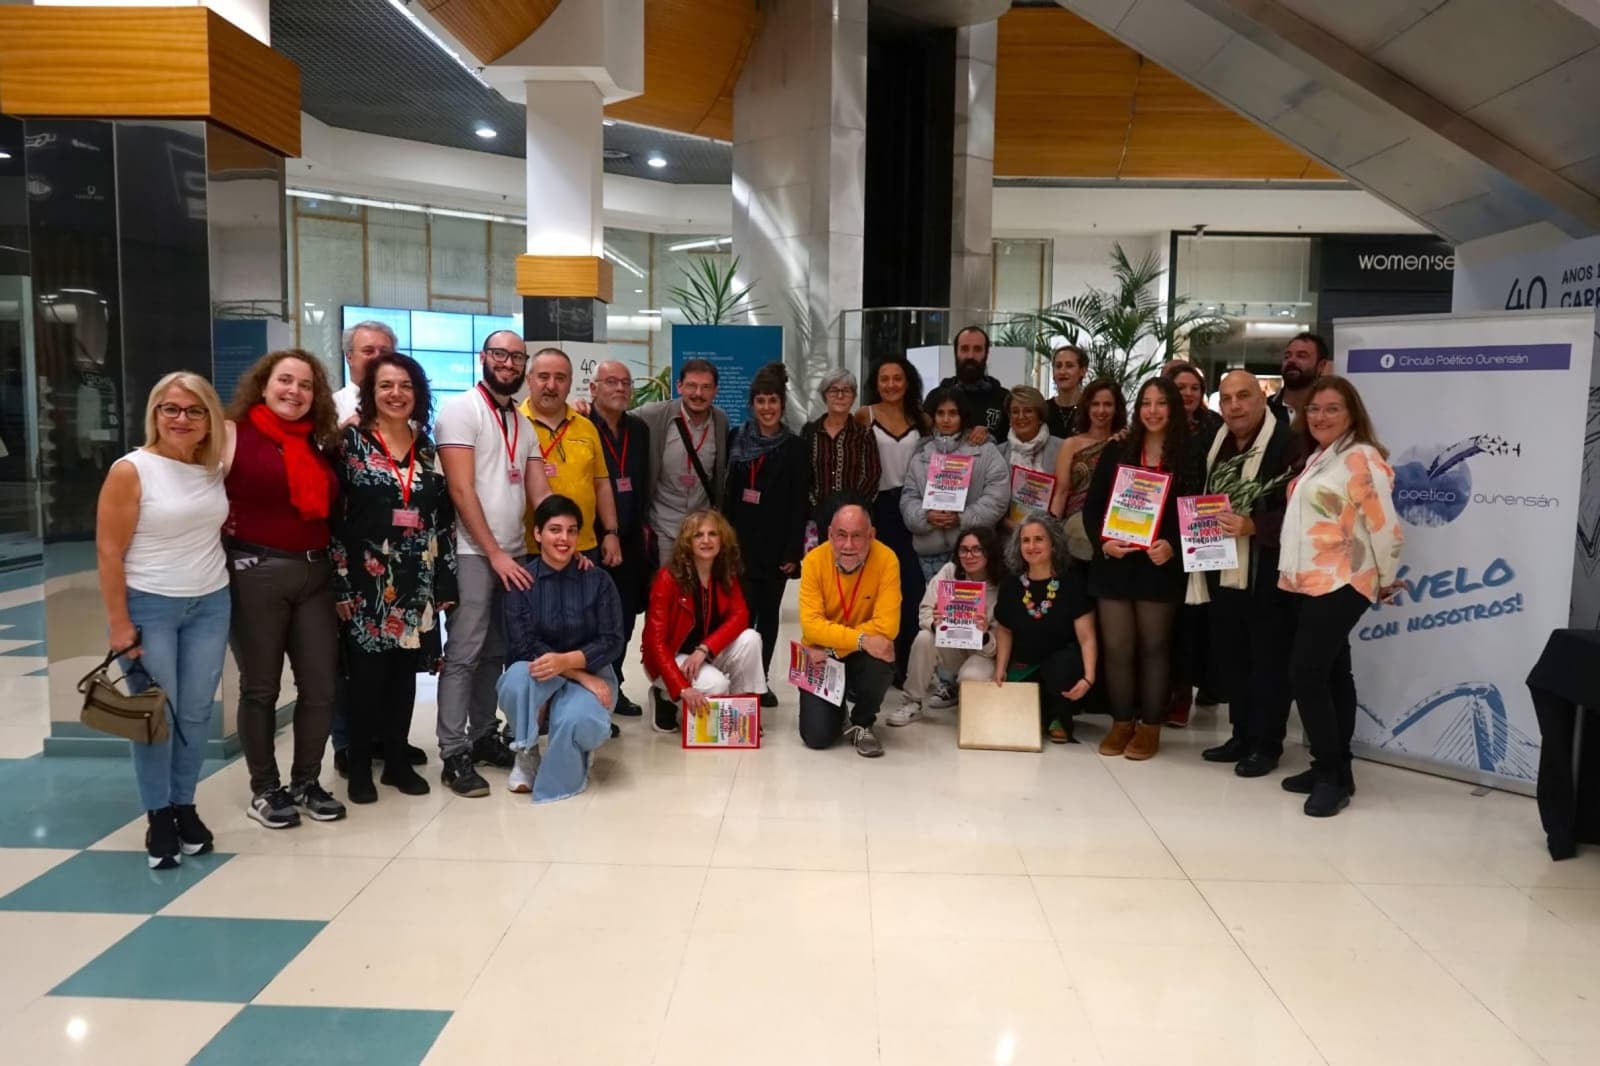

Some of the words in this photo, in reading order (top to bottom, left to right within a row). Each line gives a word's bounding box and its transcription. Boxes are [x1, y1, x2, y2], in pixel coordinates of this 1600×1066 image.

[1561, 264, 1593, 285] ANOS
[1505, 275, 1547, 310] 40
[1358, 620, 1400, 642] CON
[1407, 592, 1525, 633] NOSOTROS!
